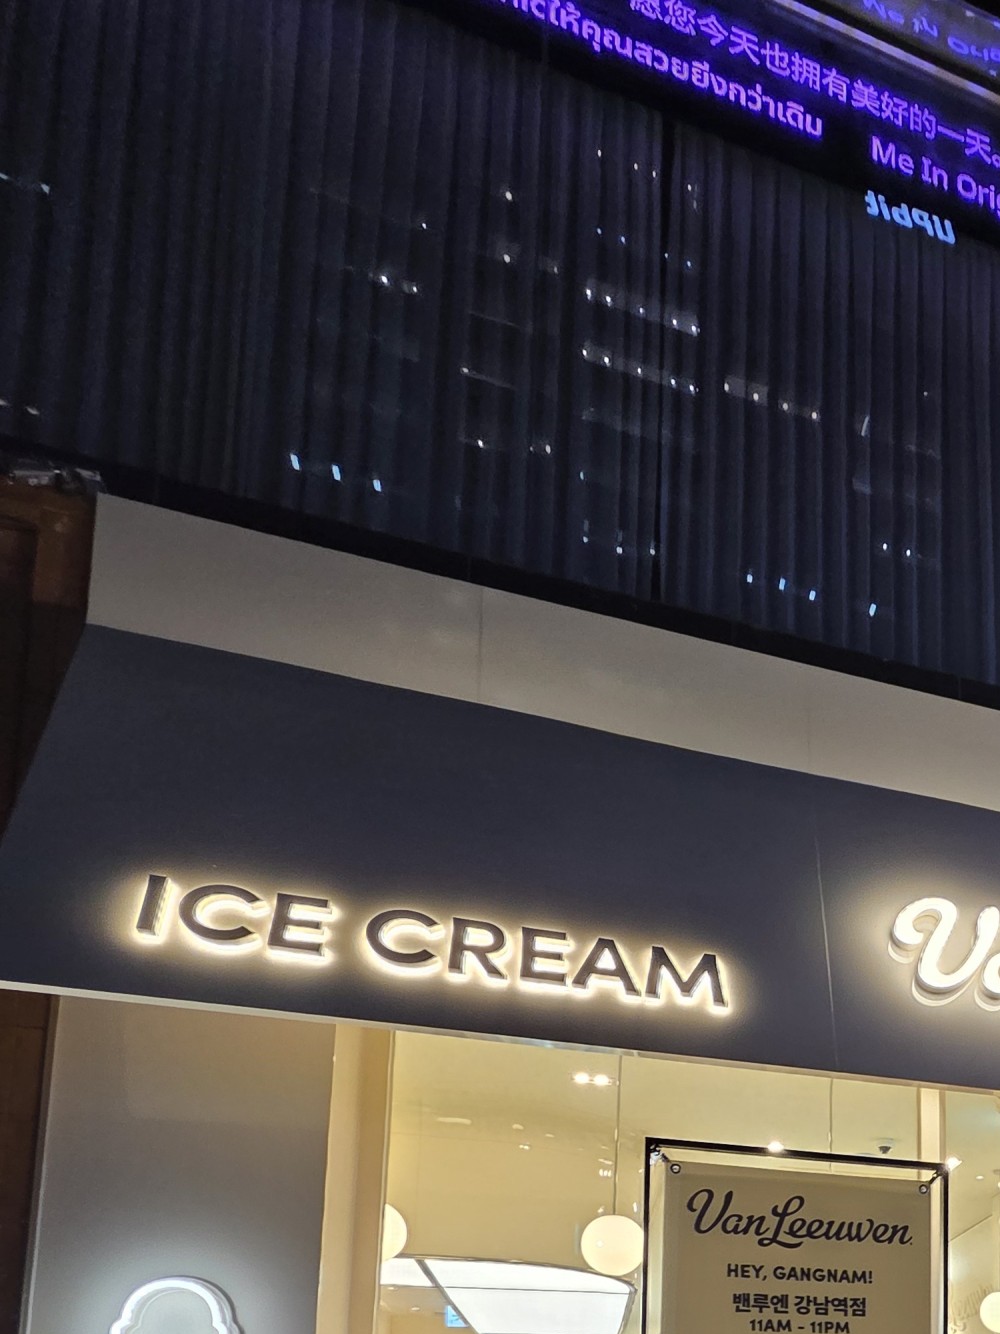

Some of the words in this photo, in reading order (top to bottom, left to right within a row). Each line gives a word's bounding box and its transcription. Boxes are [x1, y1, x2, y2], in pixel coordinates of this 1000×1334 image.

[871, 136, 913, 175] Me
[921, 157, 948, 191] In
[136, 873, 333, 958] ICE
[365, 909, 730, 1012] CREAM
[686, 1188, 771, 1235] Van
[757, 1195, 913, 1249] Leeuwen
[727, 1263, 767, 1281] HEY,
[773, 1265, 873, 1284] GANGNAM!
[794, 1295, 867, 1317] 강남역점
[749, 1319, 792, 1333] 11AM
[810, 1321, 850, 1334] 11PM
